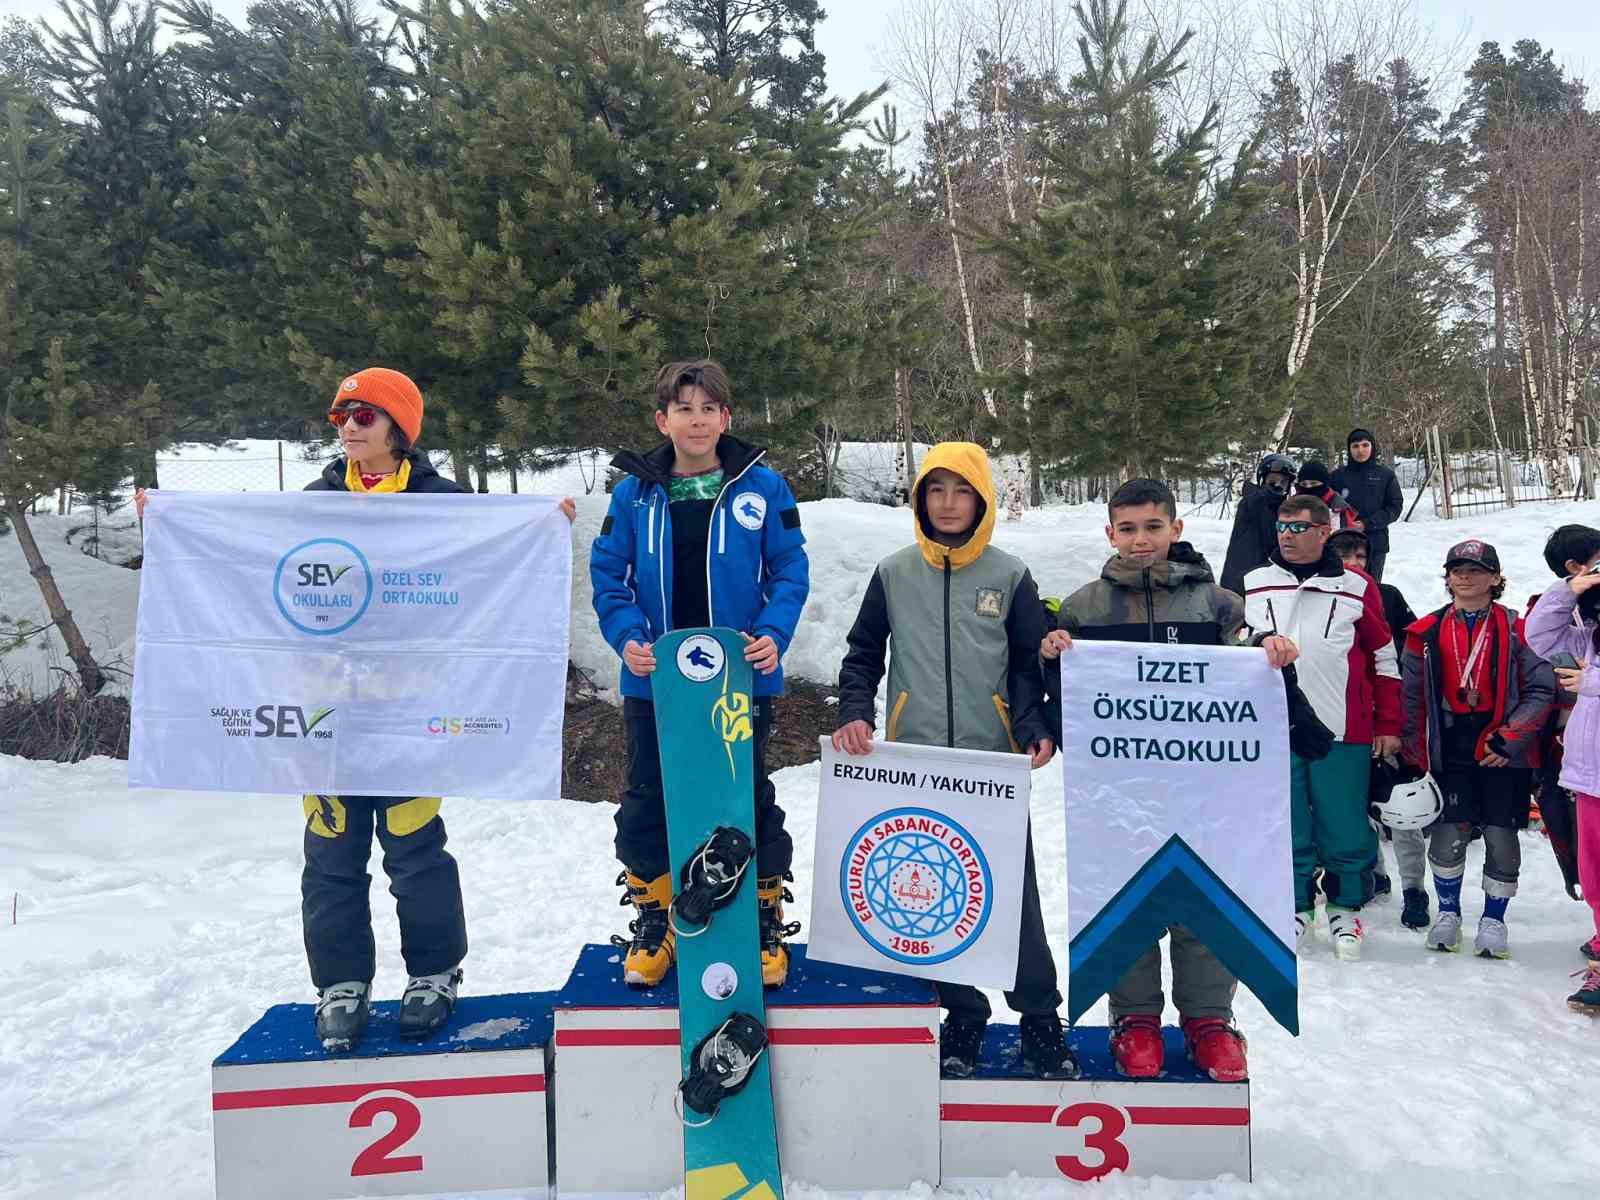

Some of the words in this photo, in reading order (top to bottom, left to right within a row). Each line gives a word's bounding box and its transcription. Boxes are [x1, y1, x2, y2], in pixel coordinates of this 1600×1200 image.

[297, 563, 353, 587] SEV
[382, 570, 413, 586] ÖZEL
[418, 573, 442, 586] SEV
[293, 593, 352, 608] OKULLARI
[382, 590, 458, 605] ORTAOKULU
[1137, 656, 1210, 684] İZZET
[210, 706, 240, 717] SAĞLIK
[242, 709, 251, 717] VE
[1093, 692, 1258, 722] ÖKSÜZKAYA
[223, 717, 252, 727] EĞİTİM
[226, 728, 251, 737] VAKFI
[254, 705, 336, 738] SEV
[314, 730, 333, 738] 1968
[1090, 736, 1260, 762] ORTAOKULU
[833, 763, 916, 787] ERZURUM
[931, 775, 1015, 799] YAKUTİYE
[849, 837, 875, 922] ERZURUM
[874, 817, 949, 840] SABANCI
[950, 836, 983, 939] ORTAOKULU
[349, 1097, 423, 1177] 2
[1056, 1102, 1129, 1182] 3
